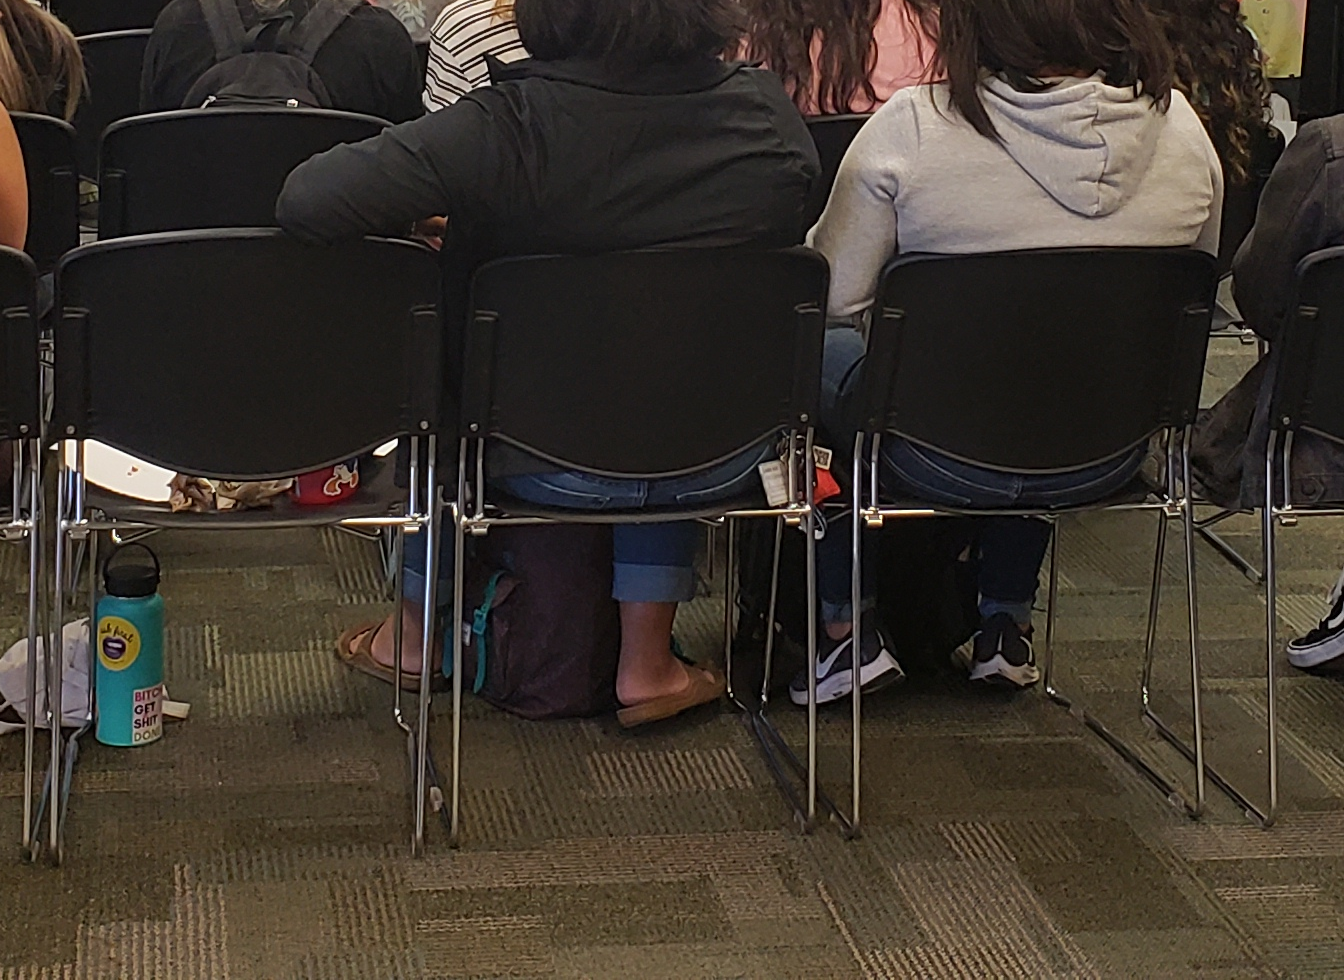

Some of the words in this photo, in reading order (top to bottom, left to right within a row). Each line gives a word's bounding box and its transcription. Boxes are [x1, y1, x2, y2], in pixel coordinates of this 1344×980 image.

[135, 687, 162, 702] BITC
[134, 701, 156, 715] GET
[134, 715, 158, 729] SHIT
[134, 726, 161, 742] DON
